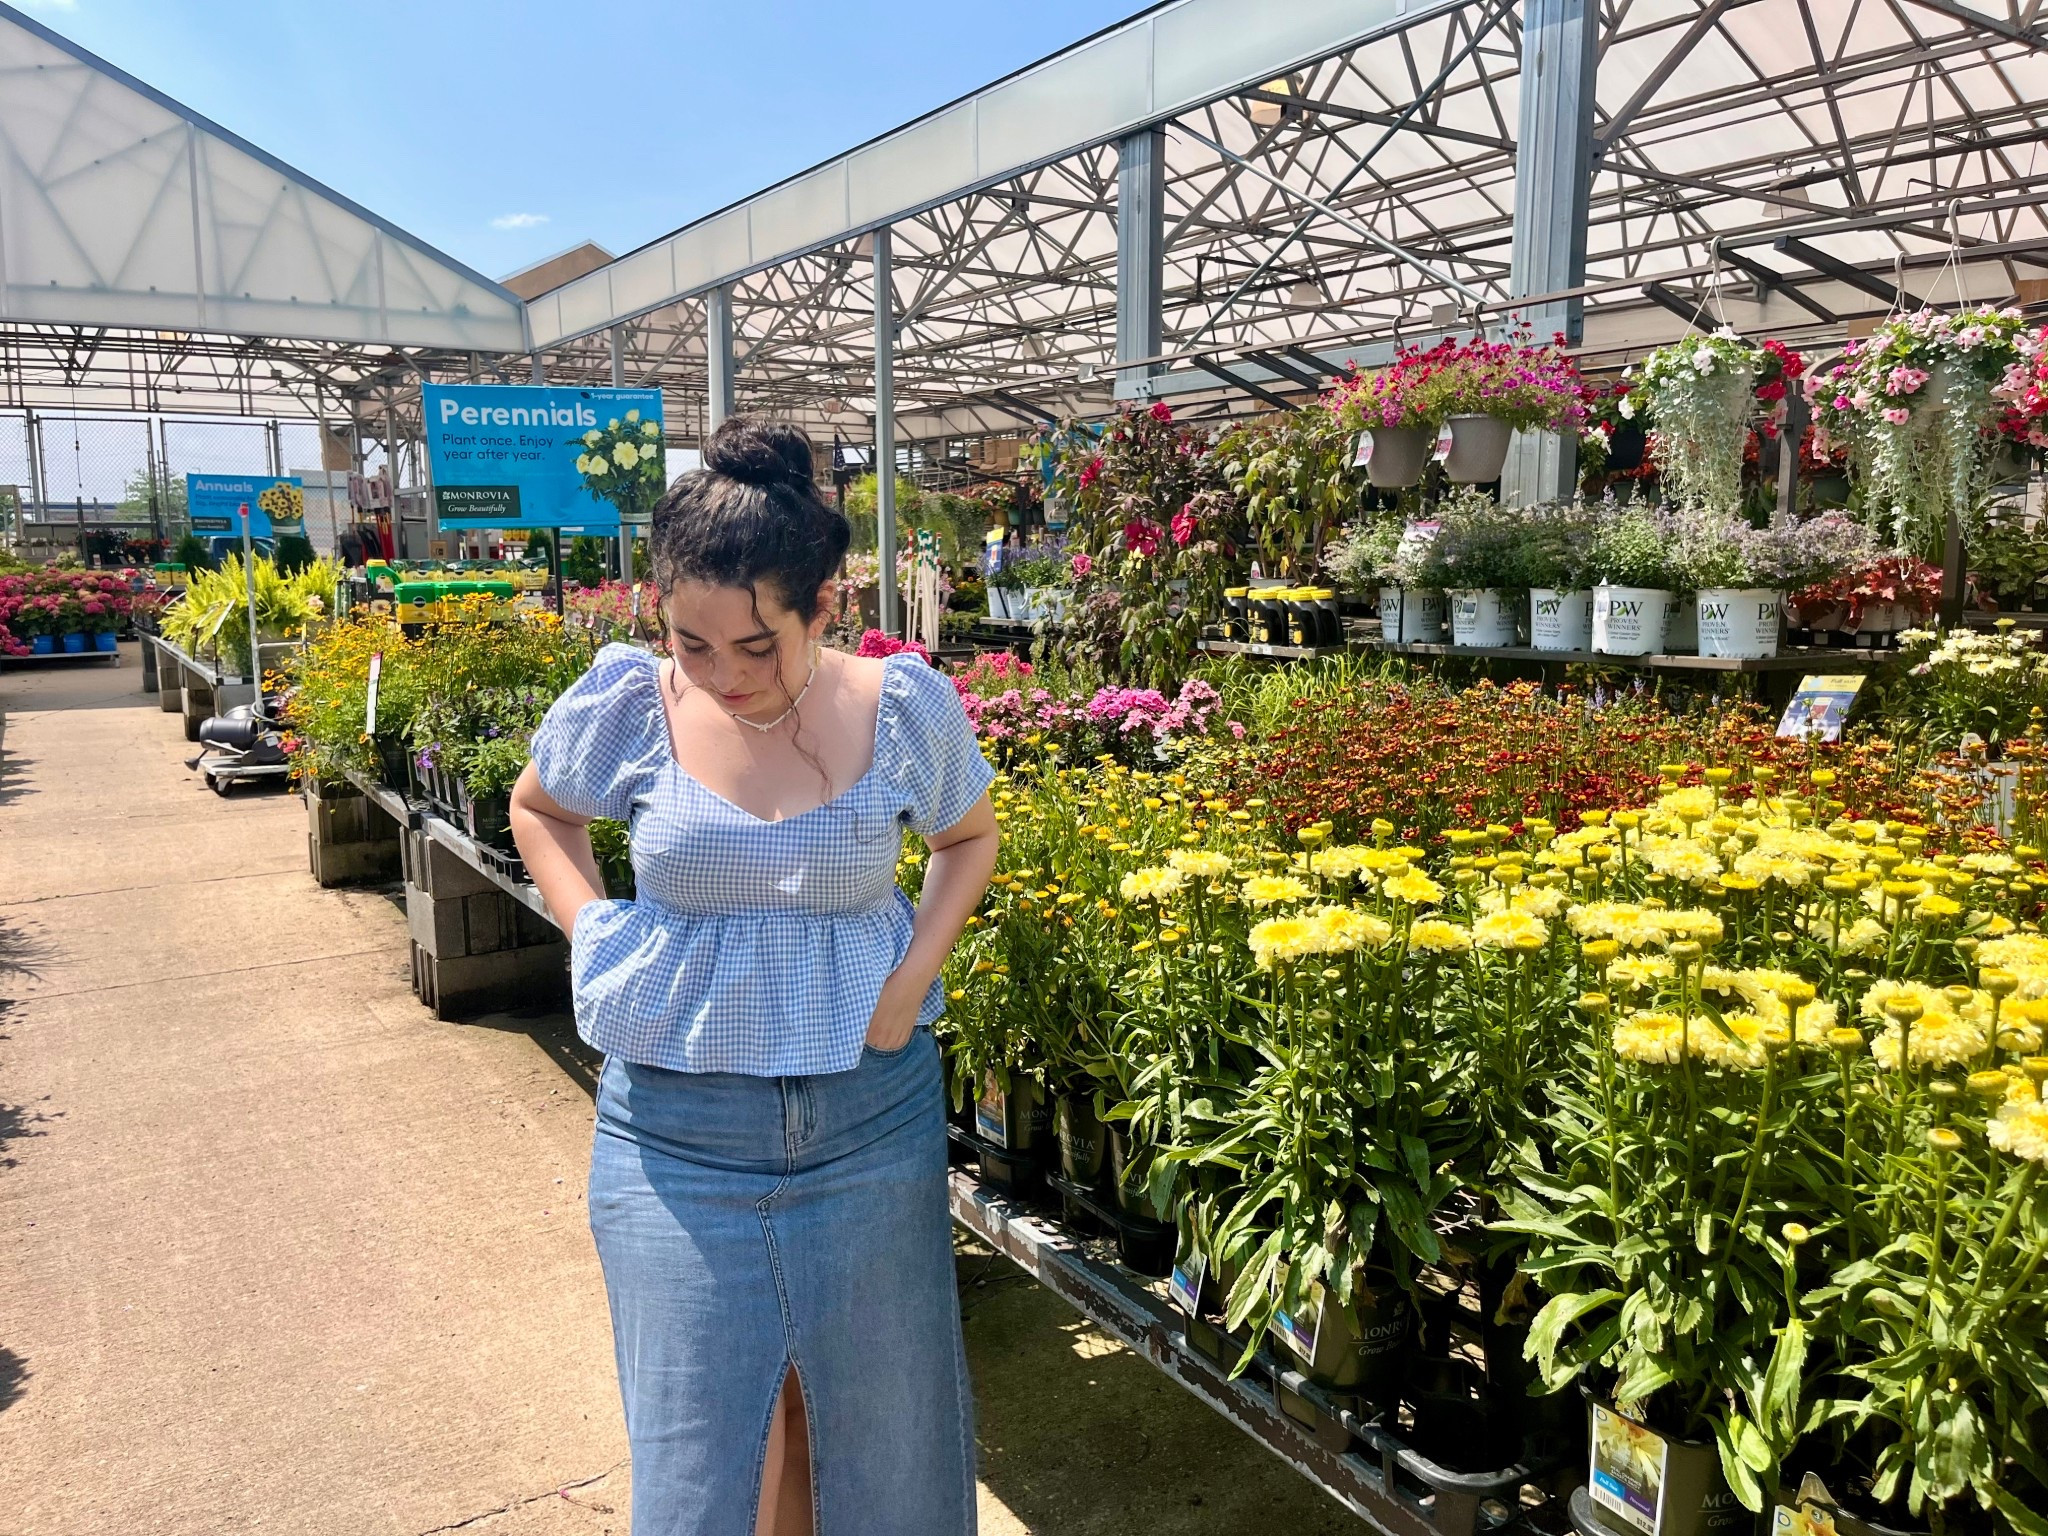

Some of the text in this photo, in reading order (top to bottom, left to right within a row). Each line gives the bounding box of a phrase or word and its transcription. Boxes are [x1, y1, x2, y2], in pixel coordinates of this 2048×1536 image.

[615, 393, 654, 401] guarantee
[440, 398, 597, 427] Perennials
[442, 433, 553, 448] Plant once. Enjoy
[443, 448, 545, 462] year after year.
[195, 479, 253, 493] Annuals
[450, 490, 510, 500] MONROVIA
[447, 503, 507, 514] Grow Beautifully
[1381, 598, 1400, 612] PW
[1536, 599, 1562, 616] PW
[1609, 600, 1644, 617] PW
[1701, 603, 1730, 620] PW
[1611, 617, 1639, 625] PROVEN
